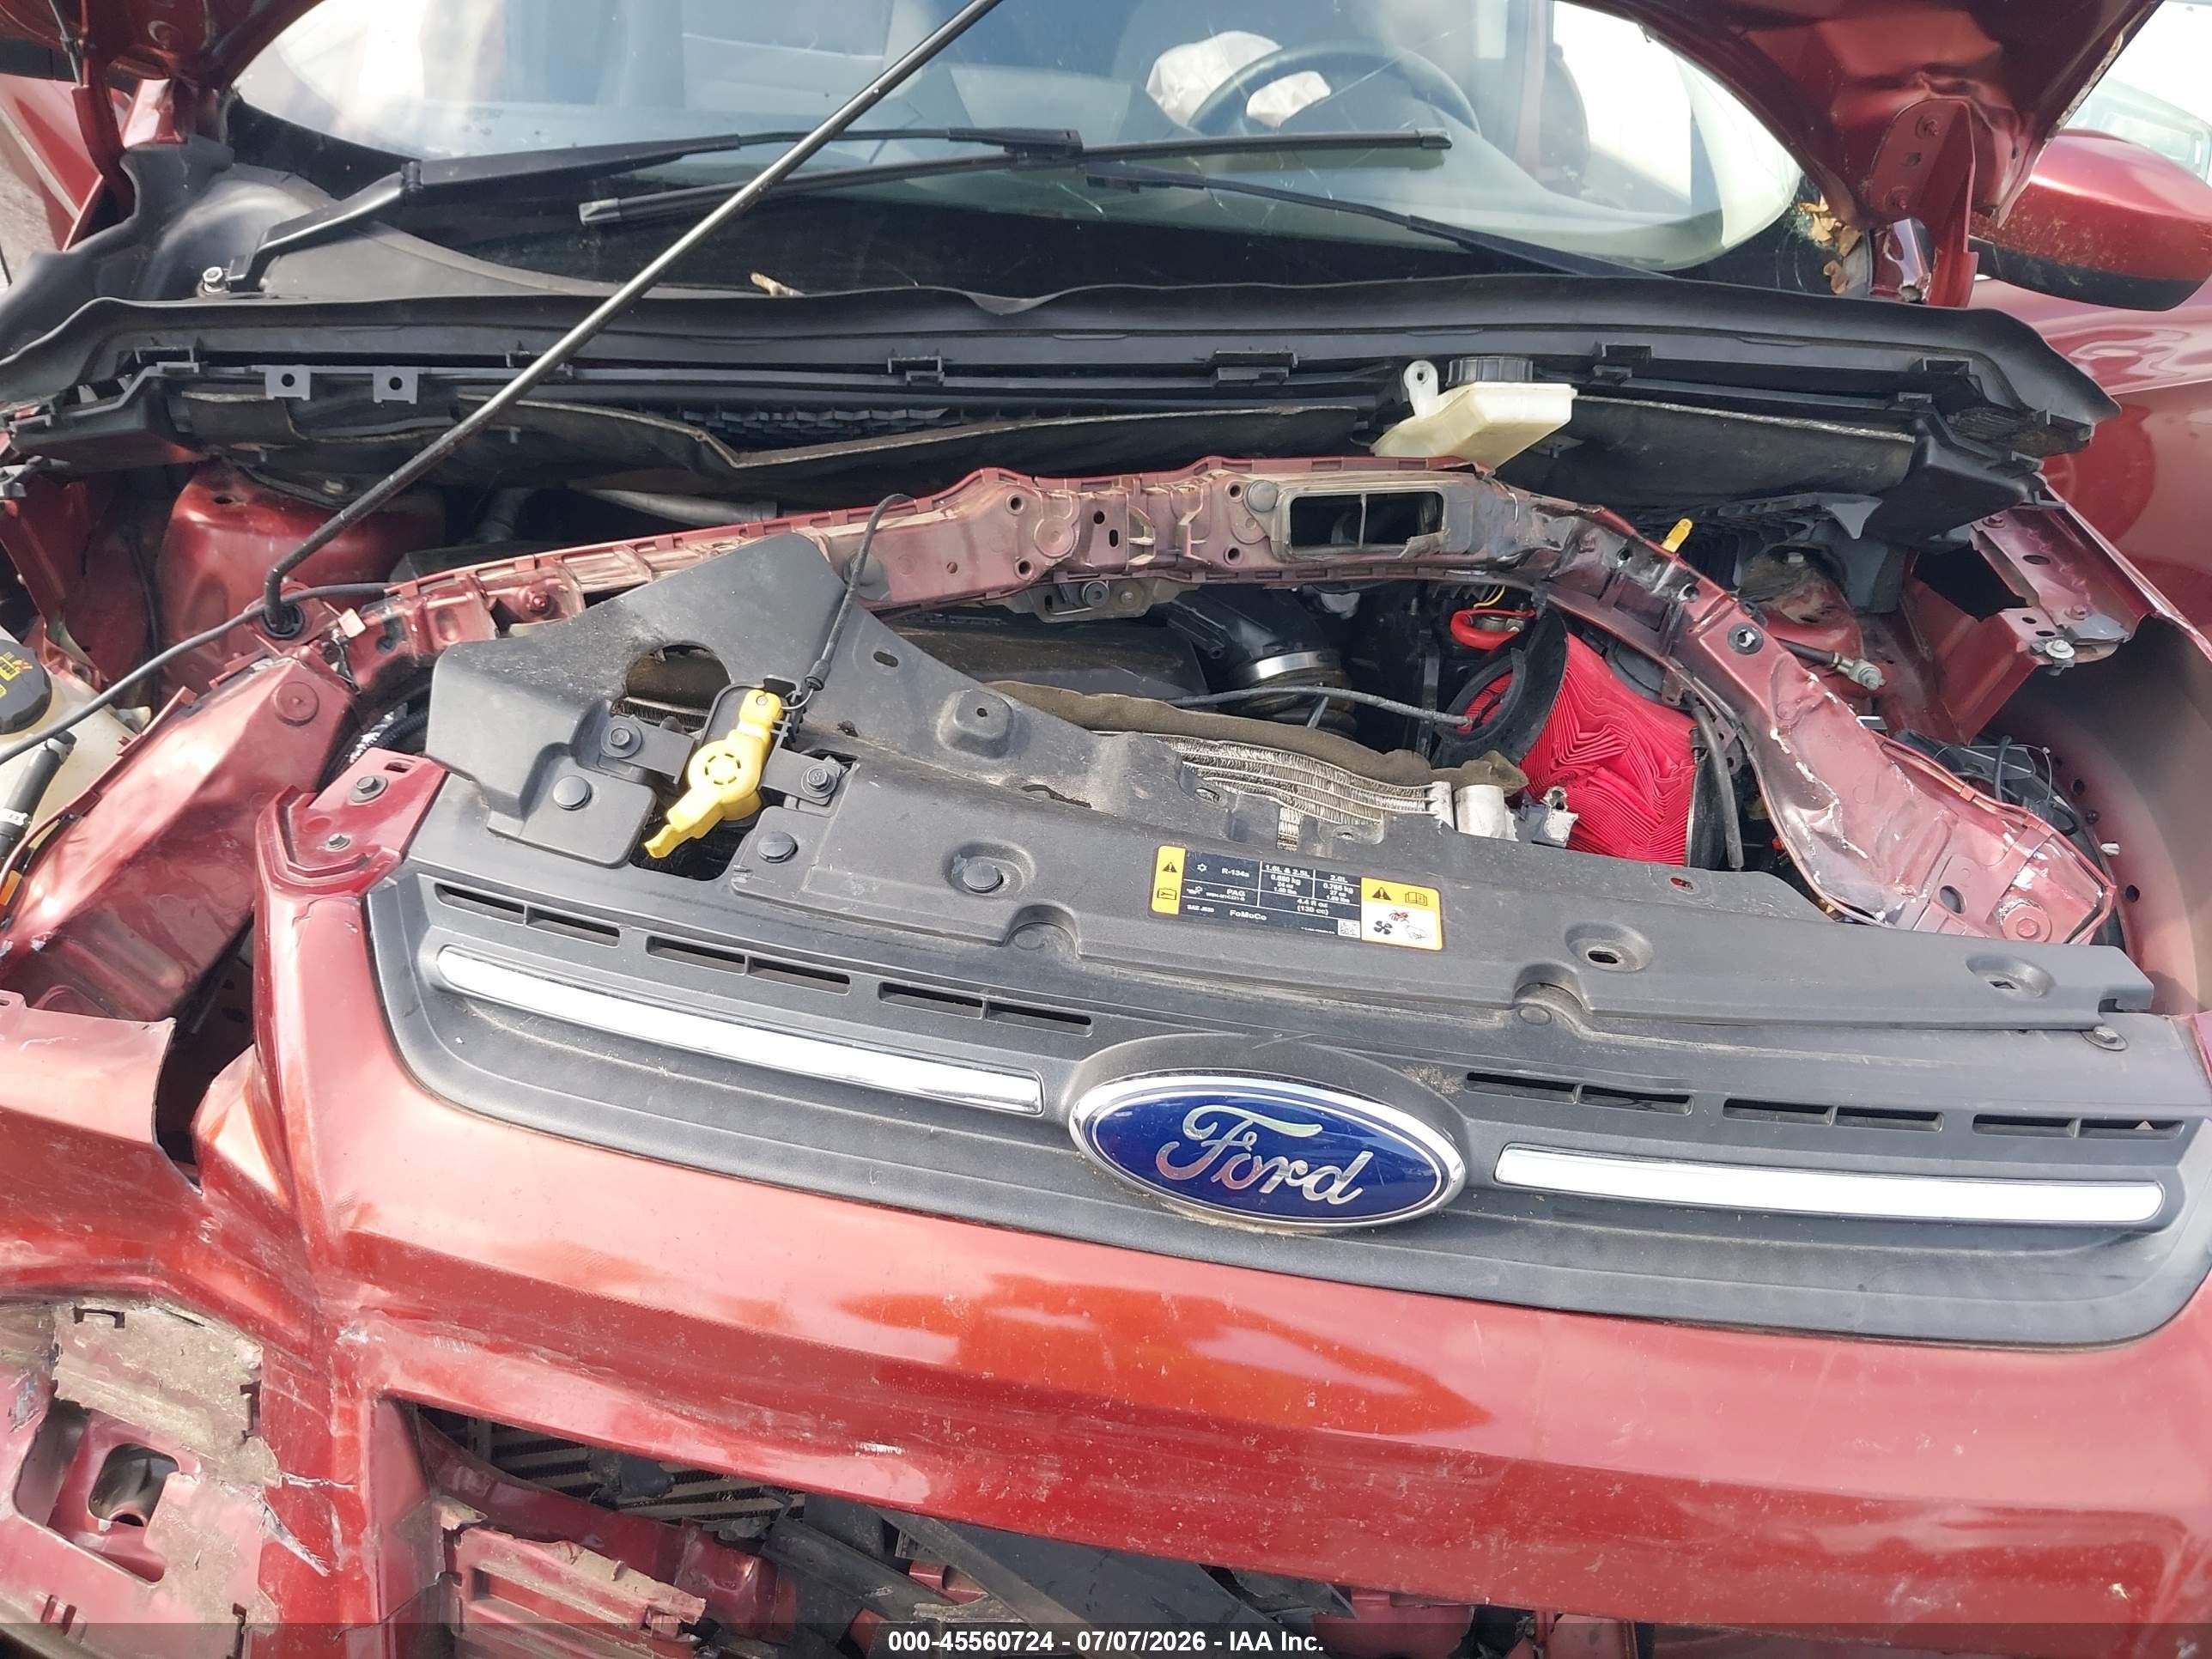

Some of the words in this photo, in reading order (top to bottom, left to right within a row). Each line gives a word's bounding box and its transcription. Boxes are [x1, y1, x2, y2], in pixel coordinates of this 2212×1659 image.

[1221, 867, 1249, 878] R-134a
[1291, 877, 1301, 885] kg
[1226, 888, 1246, 896] PAG
[1343, 885, 1353, 894] kg
[1297, 904, 1315, 913] (130
[1229, 909, 1267, 921] FoMoCo
[1156, 1104, 1374, 1205] Ford
